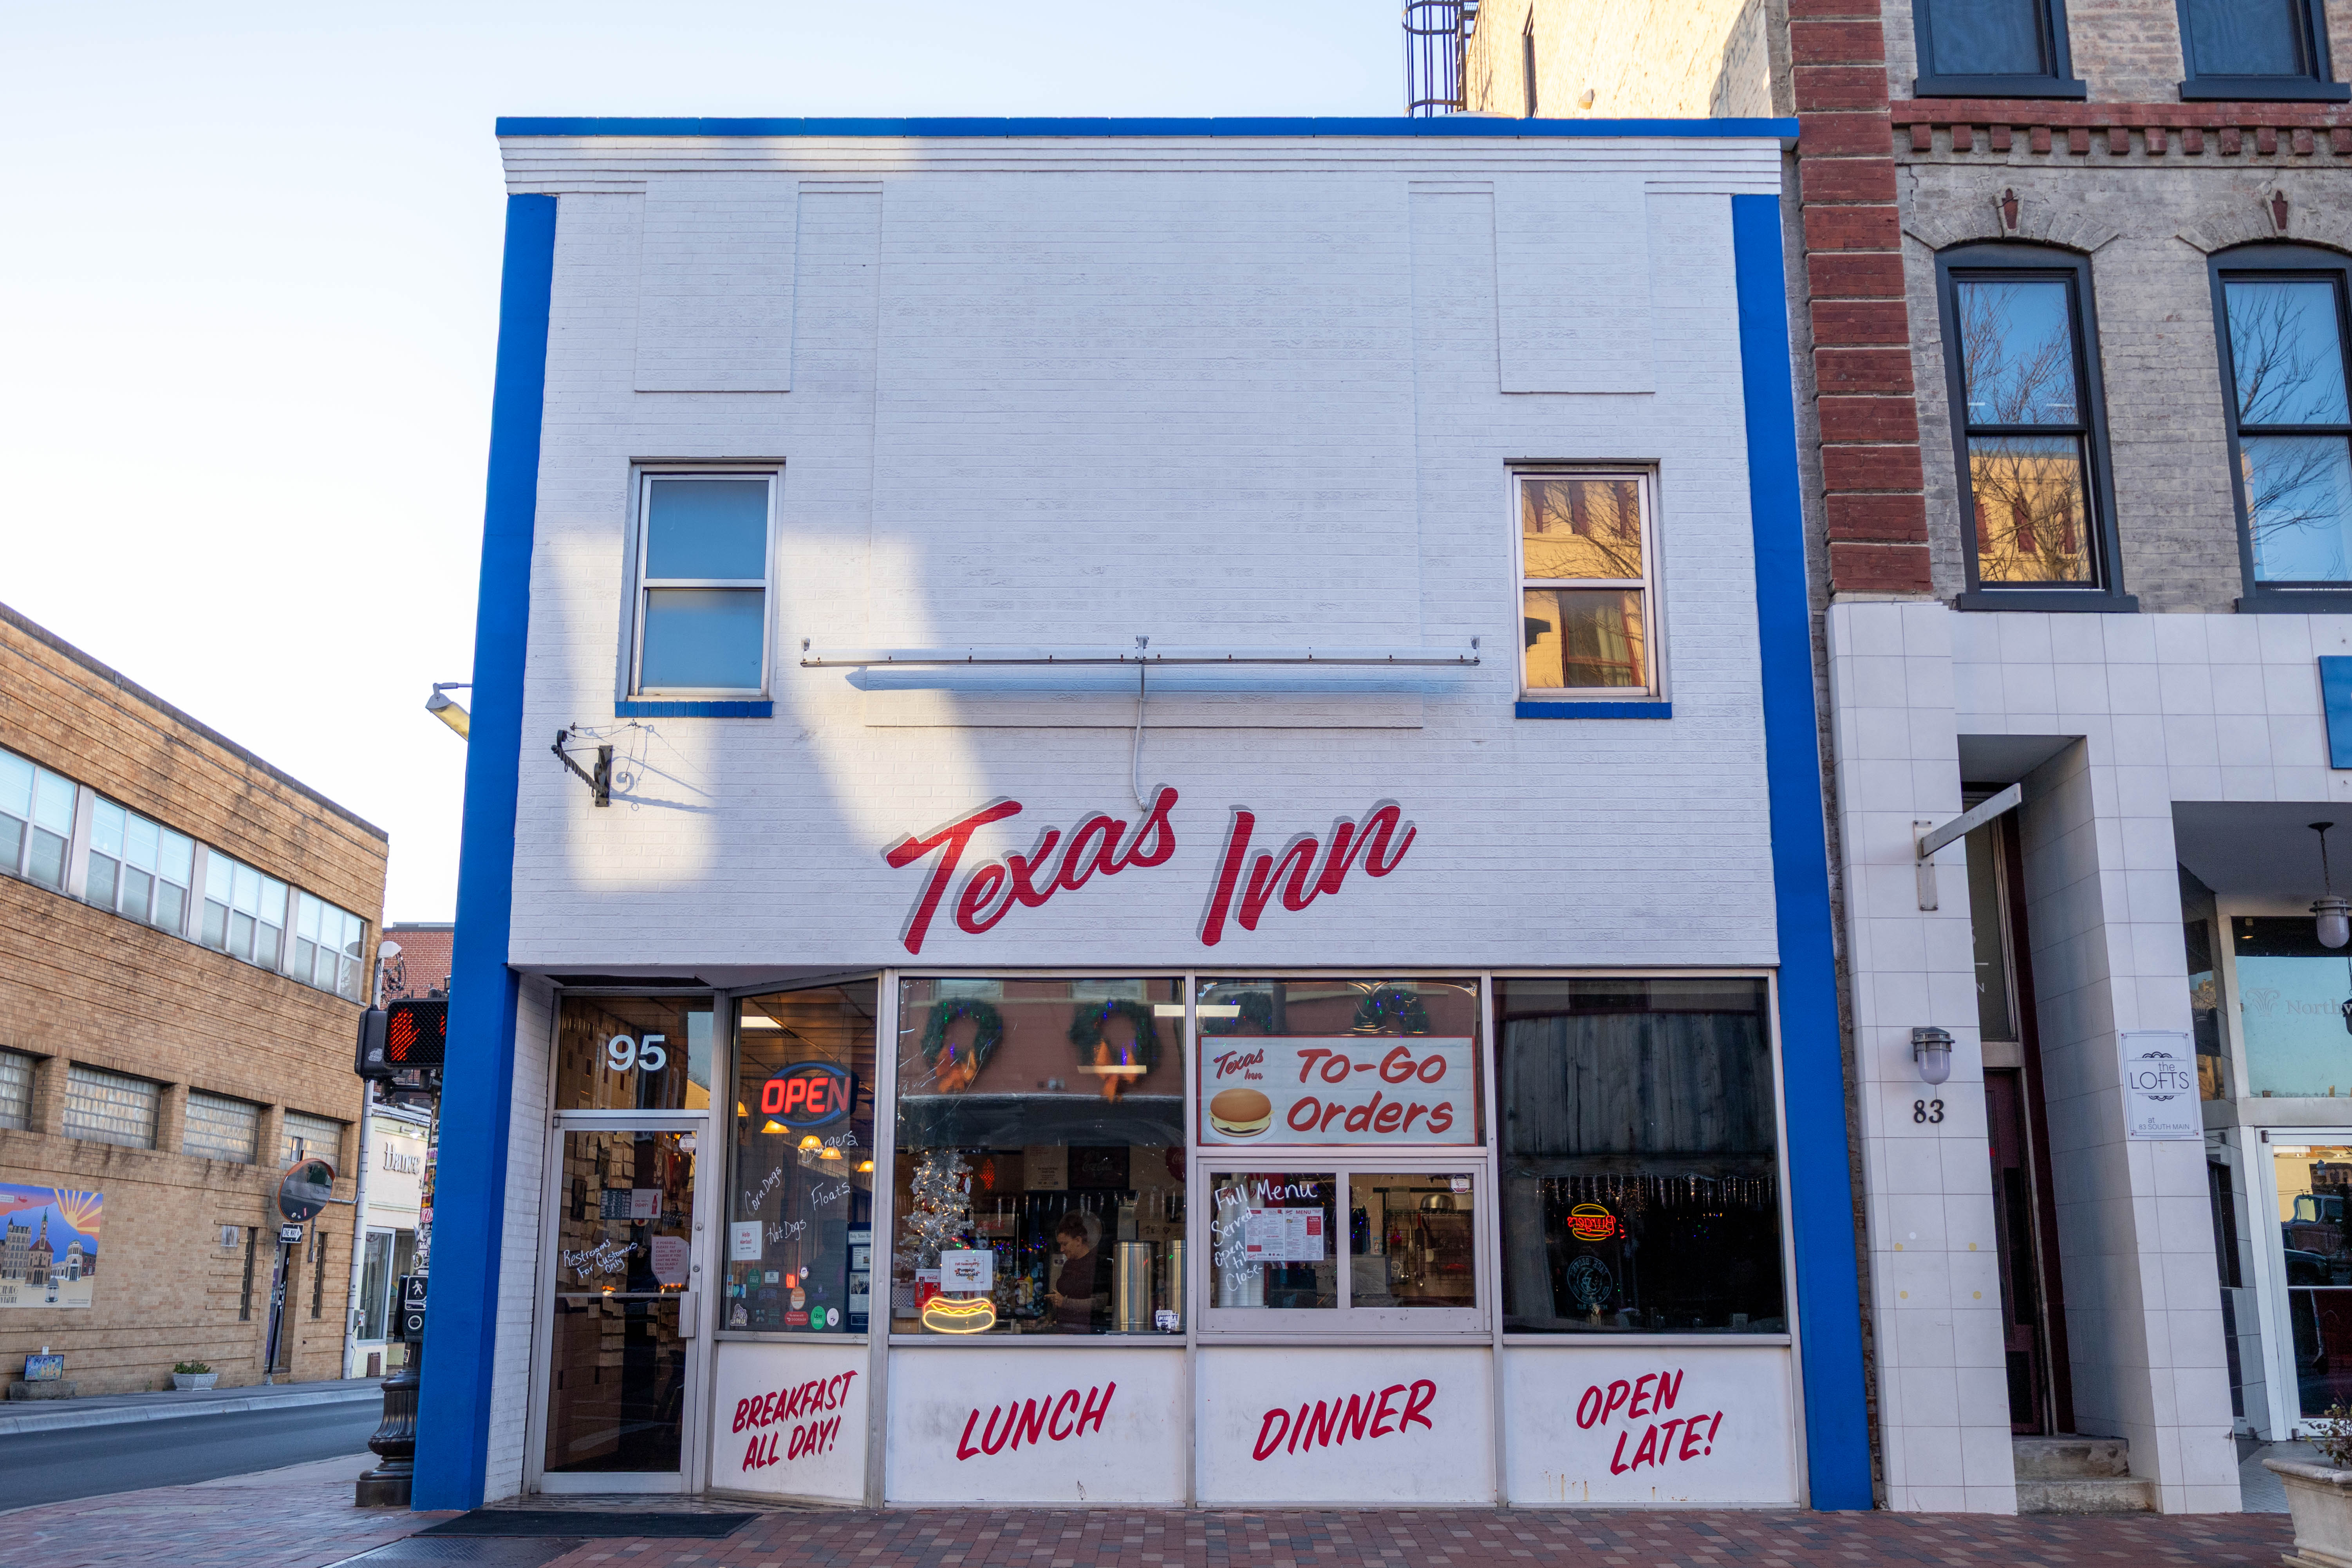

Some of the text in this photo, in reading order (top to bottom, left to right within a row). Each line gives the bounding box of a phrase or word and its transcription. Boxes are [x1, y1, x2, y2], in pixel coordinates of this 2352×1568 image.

[880, 783, 1416, 954] Texas Inn
[608, 1035, 666, 1071] 95
[1213, 1048, 1264, 1079] Texas
[1297, 1046, 1447, 1084] To-Go
[2158, 1061, 2175, 1071] the
[1244, 1068, 1263, 1080] Inn
[2130, 1072, 2189, 1089] LOFTS
[761, 1077, 851, 1114] OPEN
[1287, 1091, 1453, 1134] Orders
[1913, 1099, 1944, 1124] 83
[383, 1141, 421, 1175] Dance
[811, 1182, 851, 1210] Floats
[1215, 1184, 1248, 1211] Full
[1257, 1179, 1317, 1200] Menu
[1211, 1207, 1253, 1246] Served
[563, 1239, 611, 1267] Restrooms
[577, 1242, 638, 1279] For Customers
[732, 1370, 858, 1434] BREAKFAST
[1576, 1368, 1684, 1429] OPEN
[956, 1381, 1116, 1461] LUNCH
[1252, 1379, 1437, 1461] DINNER
[742, 1417, 841, 1472] ALL DAY!
[1610, 1411, 1723, 1476] LATE!
